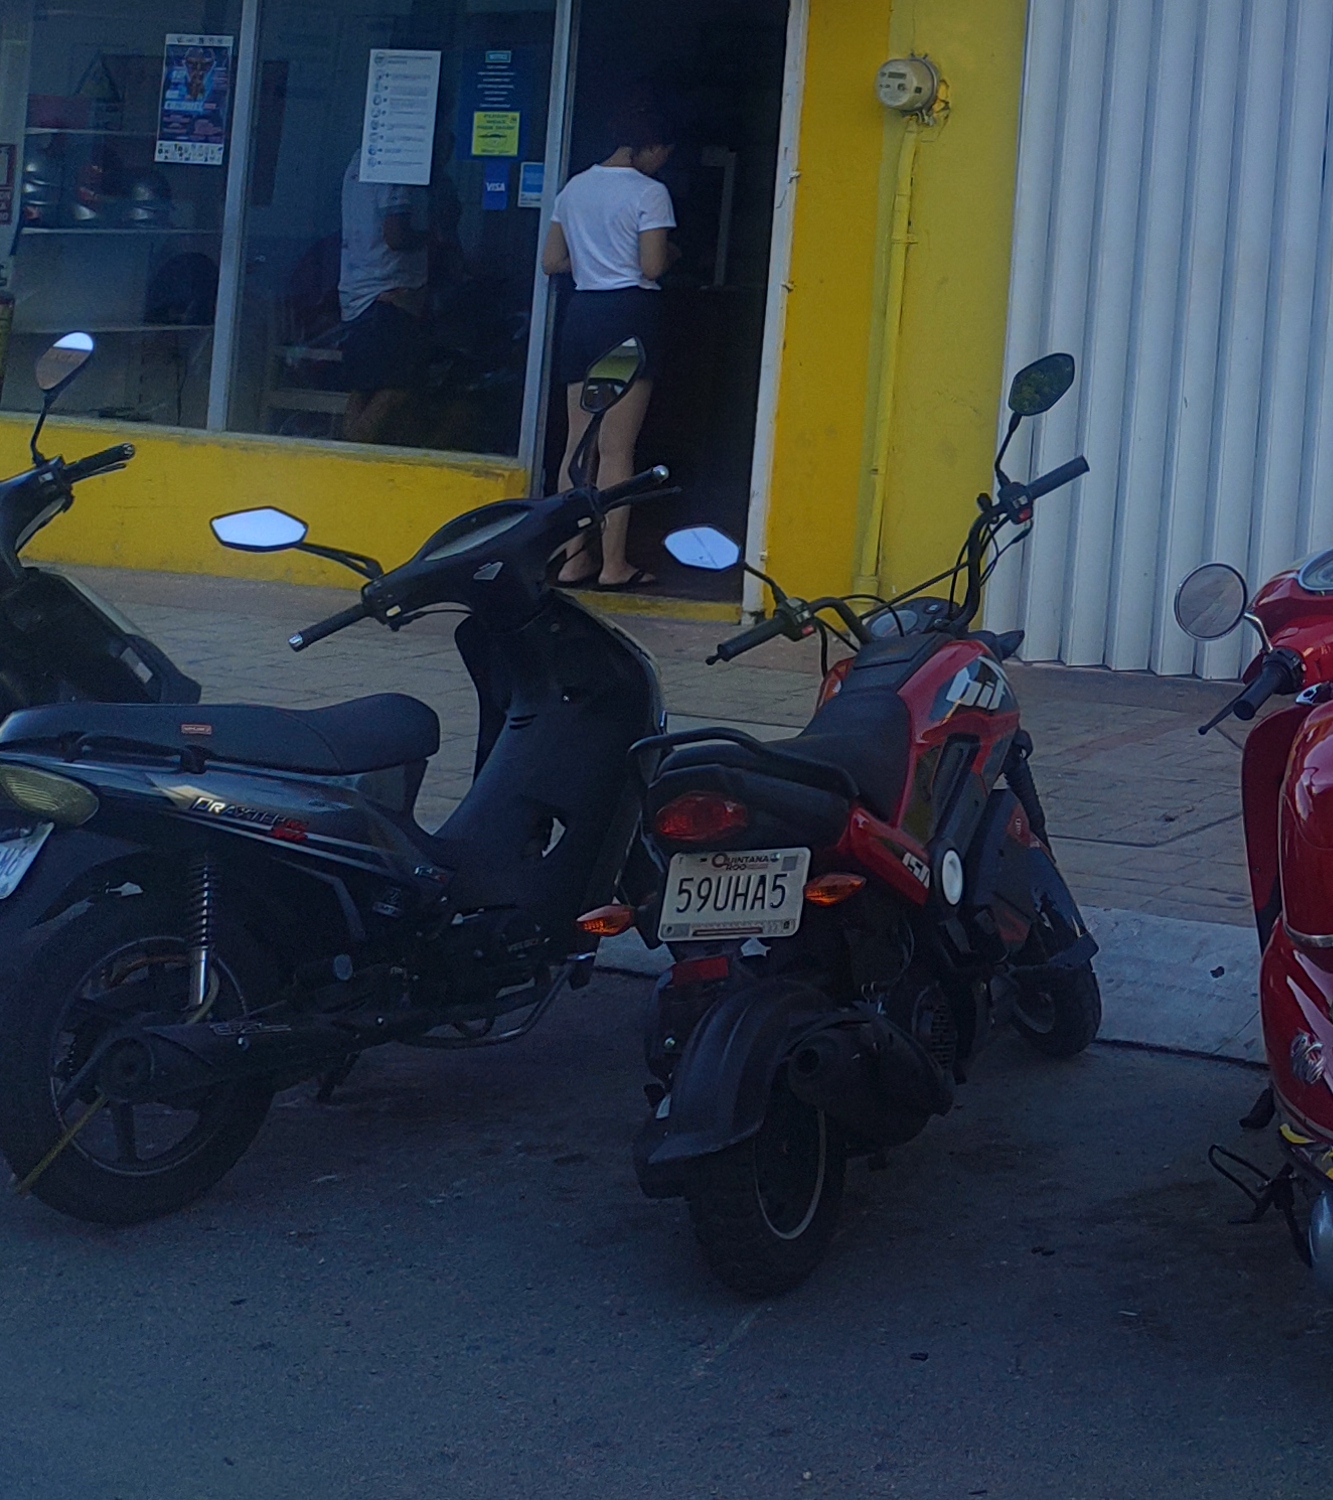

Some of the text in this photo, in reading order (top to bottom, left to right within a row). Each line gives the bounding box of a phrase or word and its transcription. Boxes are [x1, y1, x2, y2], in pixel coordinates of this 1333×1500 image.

[486, 182, 506, 192] VISA
[712, 853, 769, 868] QUINTANA
[676, 873, 788, 913] 59UHA5
